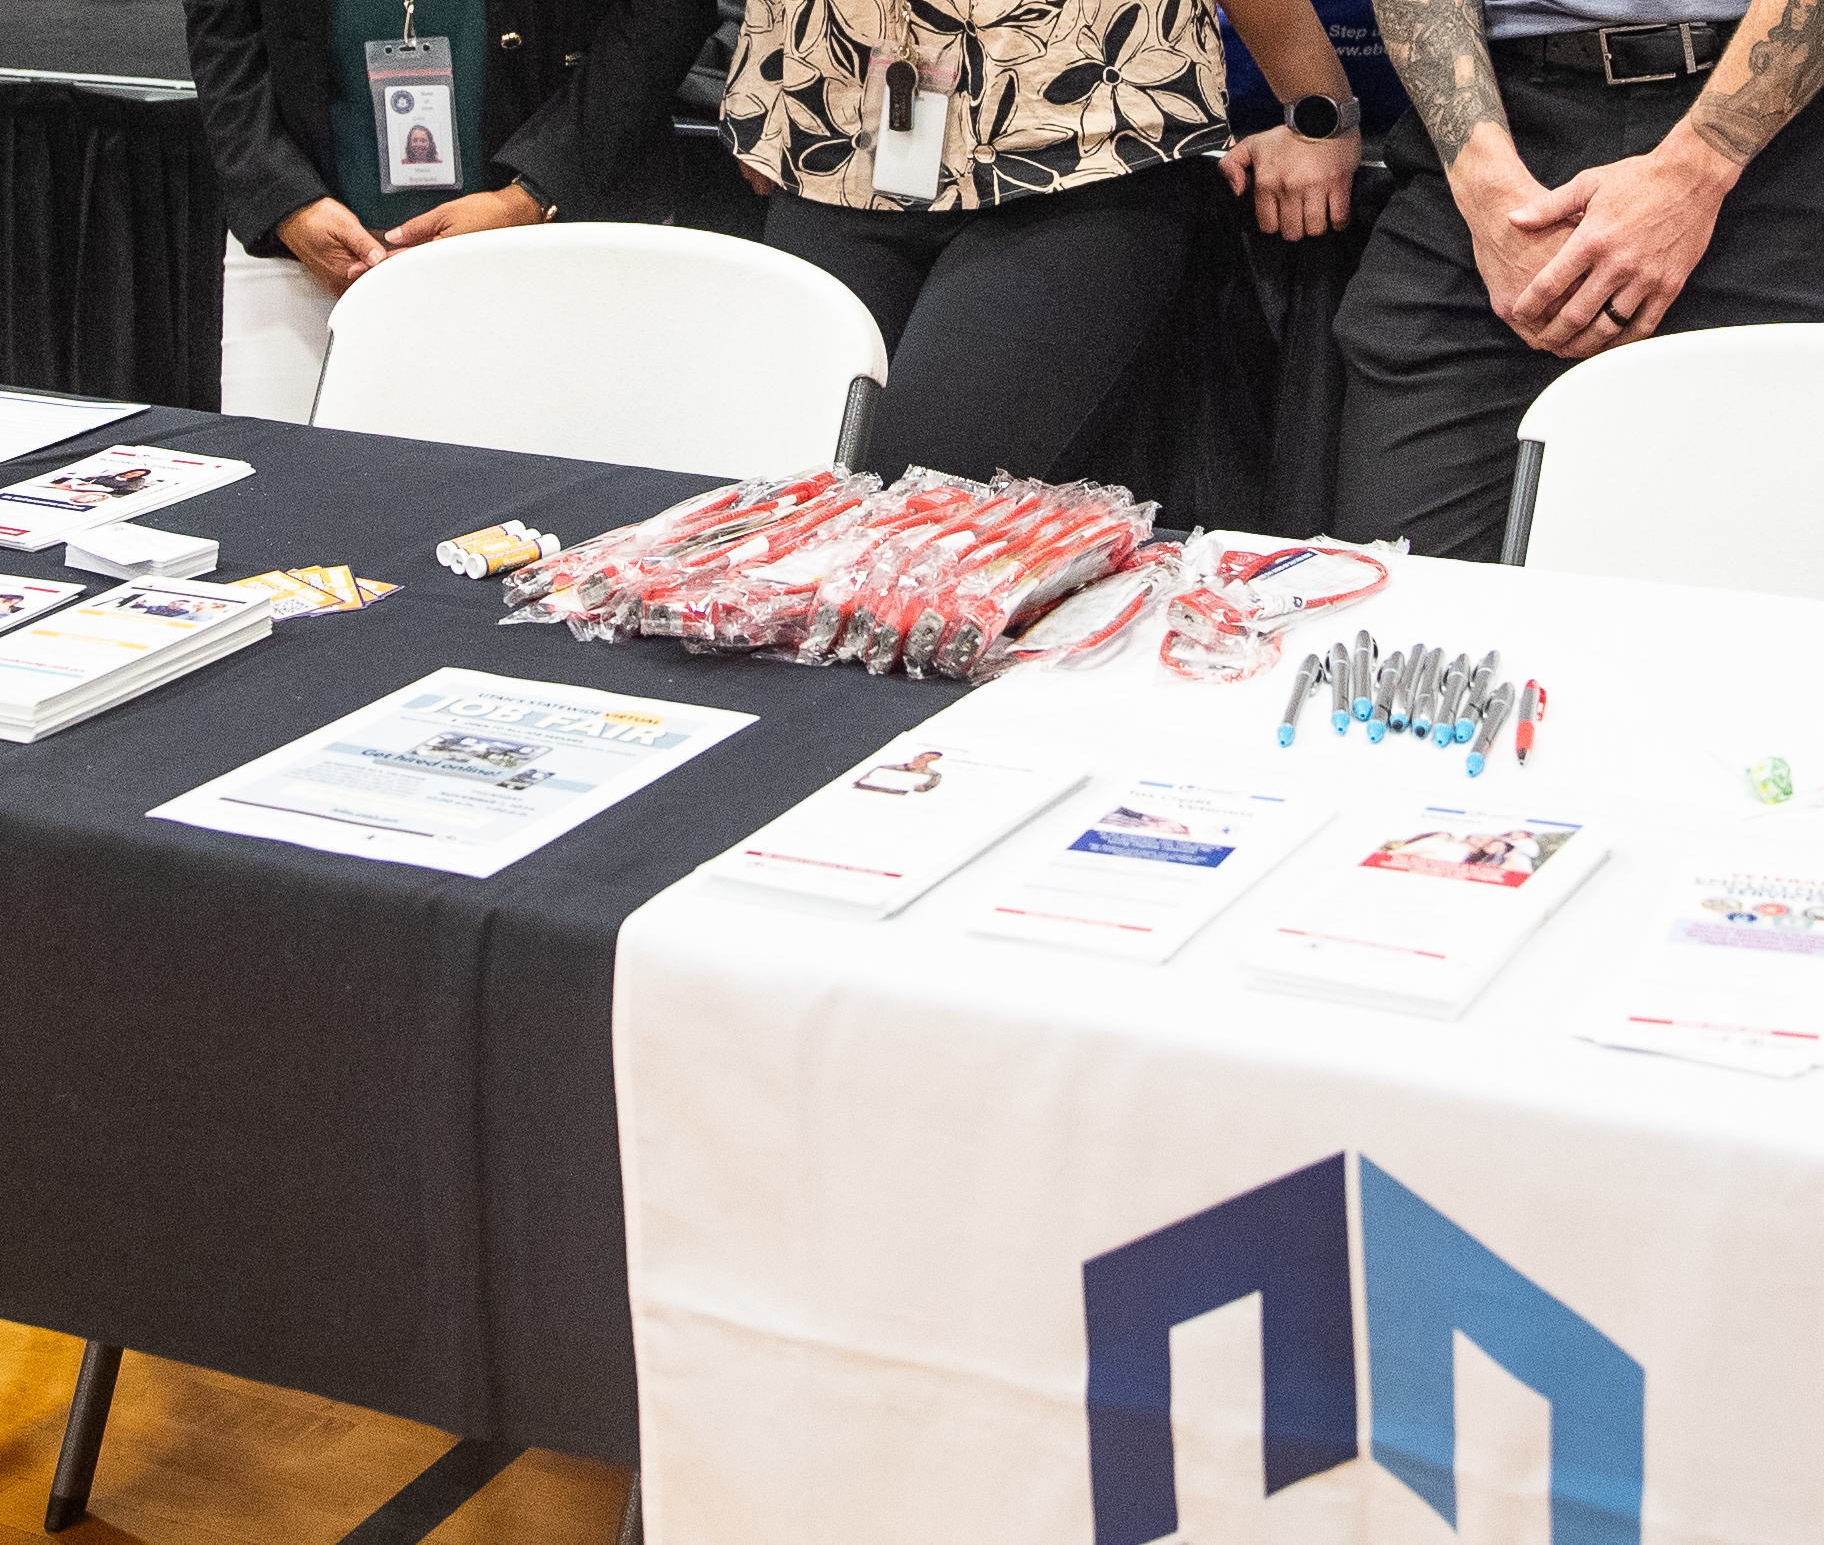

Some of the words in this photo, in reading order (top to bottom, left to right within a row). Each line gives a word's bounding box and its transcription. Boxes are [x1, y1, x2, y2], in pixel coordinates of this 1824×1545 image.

[1329, 24, 1368, 40] Step
[416, 695, 533, 723] JOB
[536, 713, 666, 746] FAIR
[528, 699, 603, 716] STATEWIDE
[605, 711, 661, 726] VIRTUAL
[393, 751, 440, 769] hired
[440, 760, 503, 778] online!
